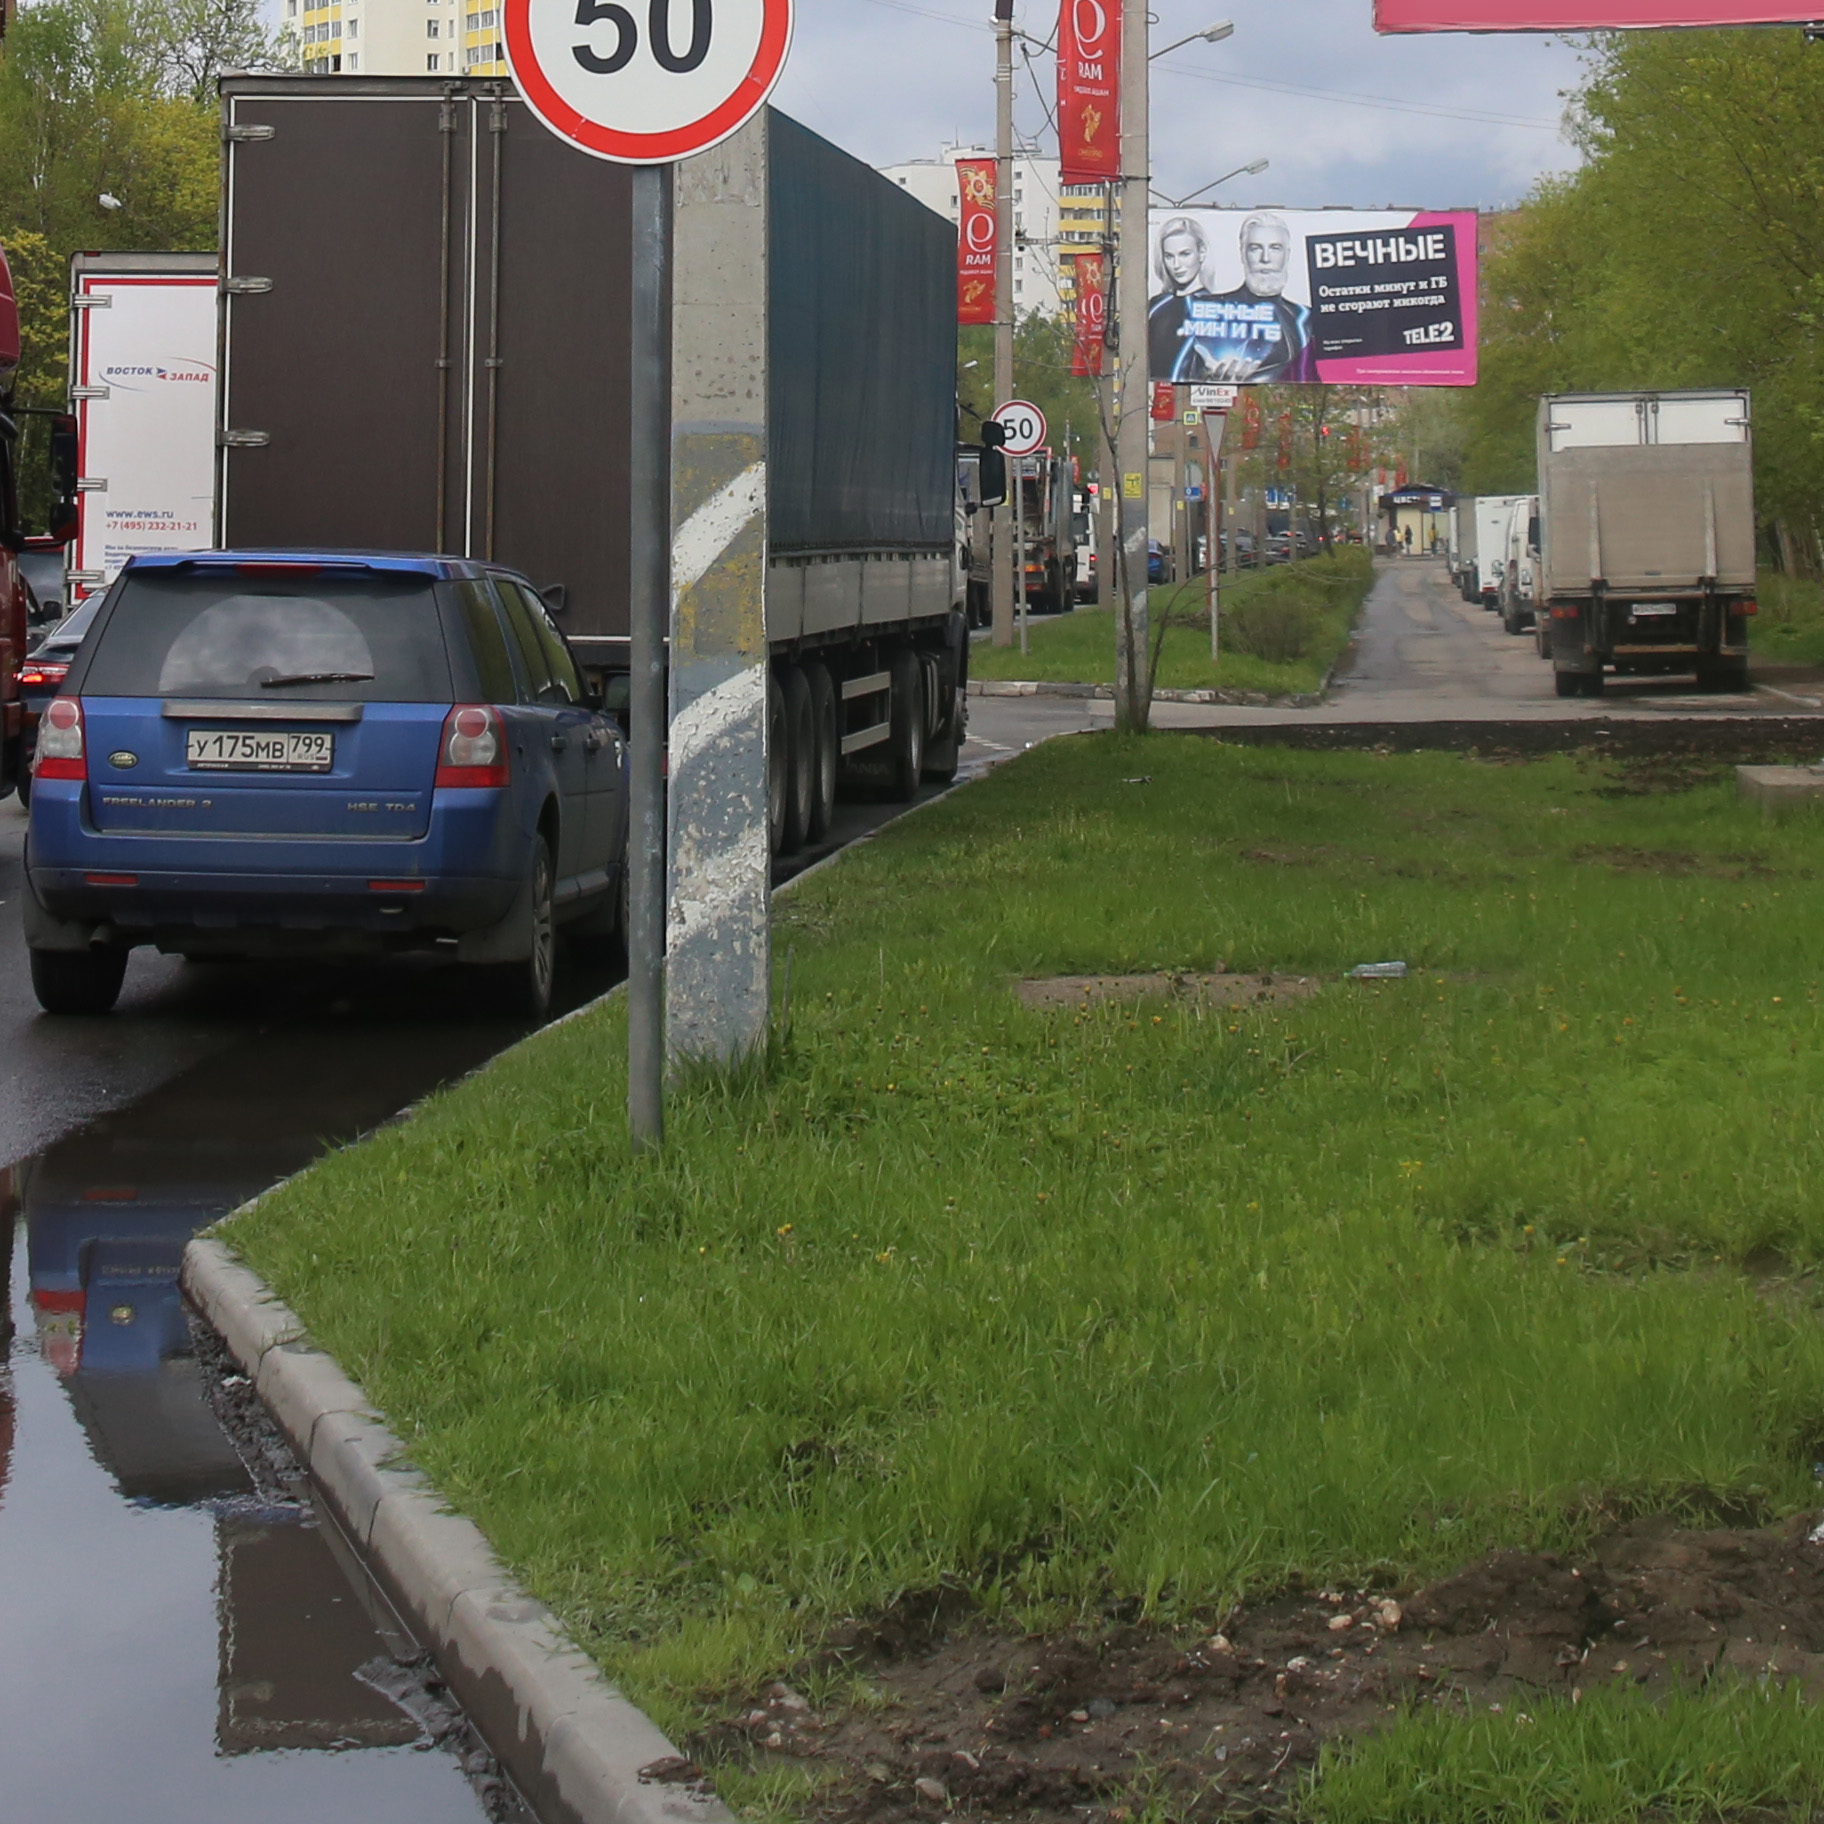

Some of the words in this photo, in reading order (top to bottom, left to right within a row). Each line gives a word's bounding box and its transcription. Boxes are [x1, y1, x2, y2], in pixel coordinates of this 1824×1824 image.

[1314, 233, 1447, 269] ВЕЧНЫЕ
[1319, 284, 1372, 298] Остатки
[1374, 280, 1417, 295] минут
[1418, 280, 1429, 290] и
[1430, 275, 1448, 289] ГБ
[1192, 301, 1275, 322] ВЕЧНЫЕ
[1320, 303, 1336, 313] не
[1338, 298, 1391, 314] сгорают
[1392, 294, 1446, 308] никогда
[1231, 322, 1248, 339] И
[1402, 321, 1455, 345] TELE2
[106, 366, 154, 376] ВОСТОК
[169, 373, 210, 383] ЗАПАД
[1002, 418, 1034, 441] 50
[105, 510, 174, 519] www.ews.ru
[105, 522, 118, 530] +7
[120, 521, 146, 531] (495)
[148, 522, 198, 531] 232-21-21
[196, 735, 285, 759] У175МВ
[290, 735, 325, 754] 799
[102, 796, 196, 809] FREELANDER
[385, 803, 417, 812] TD4
